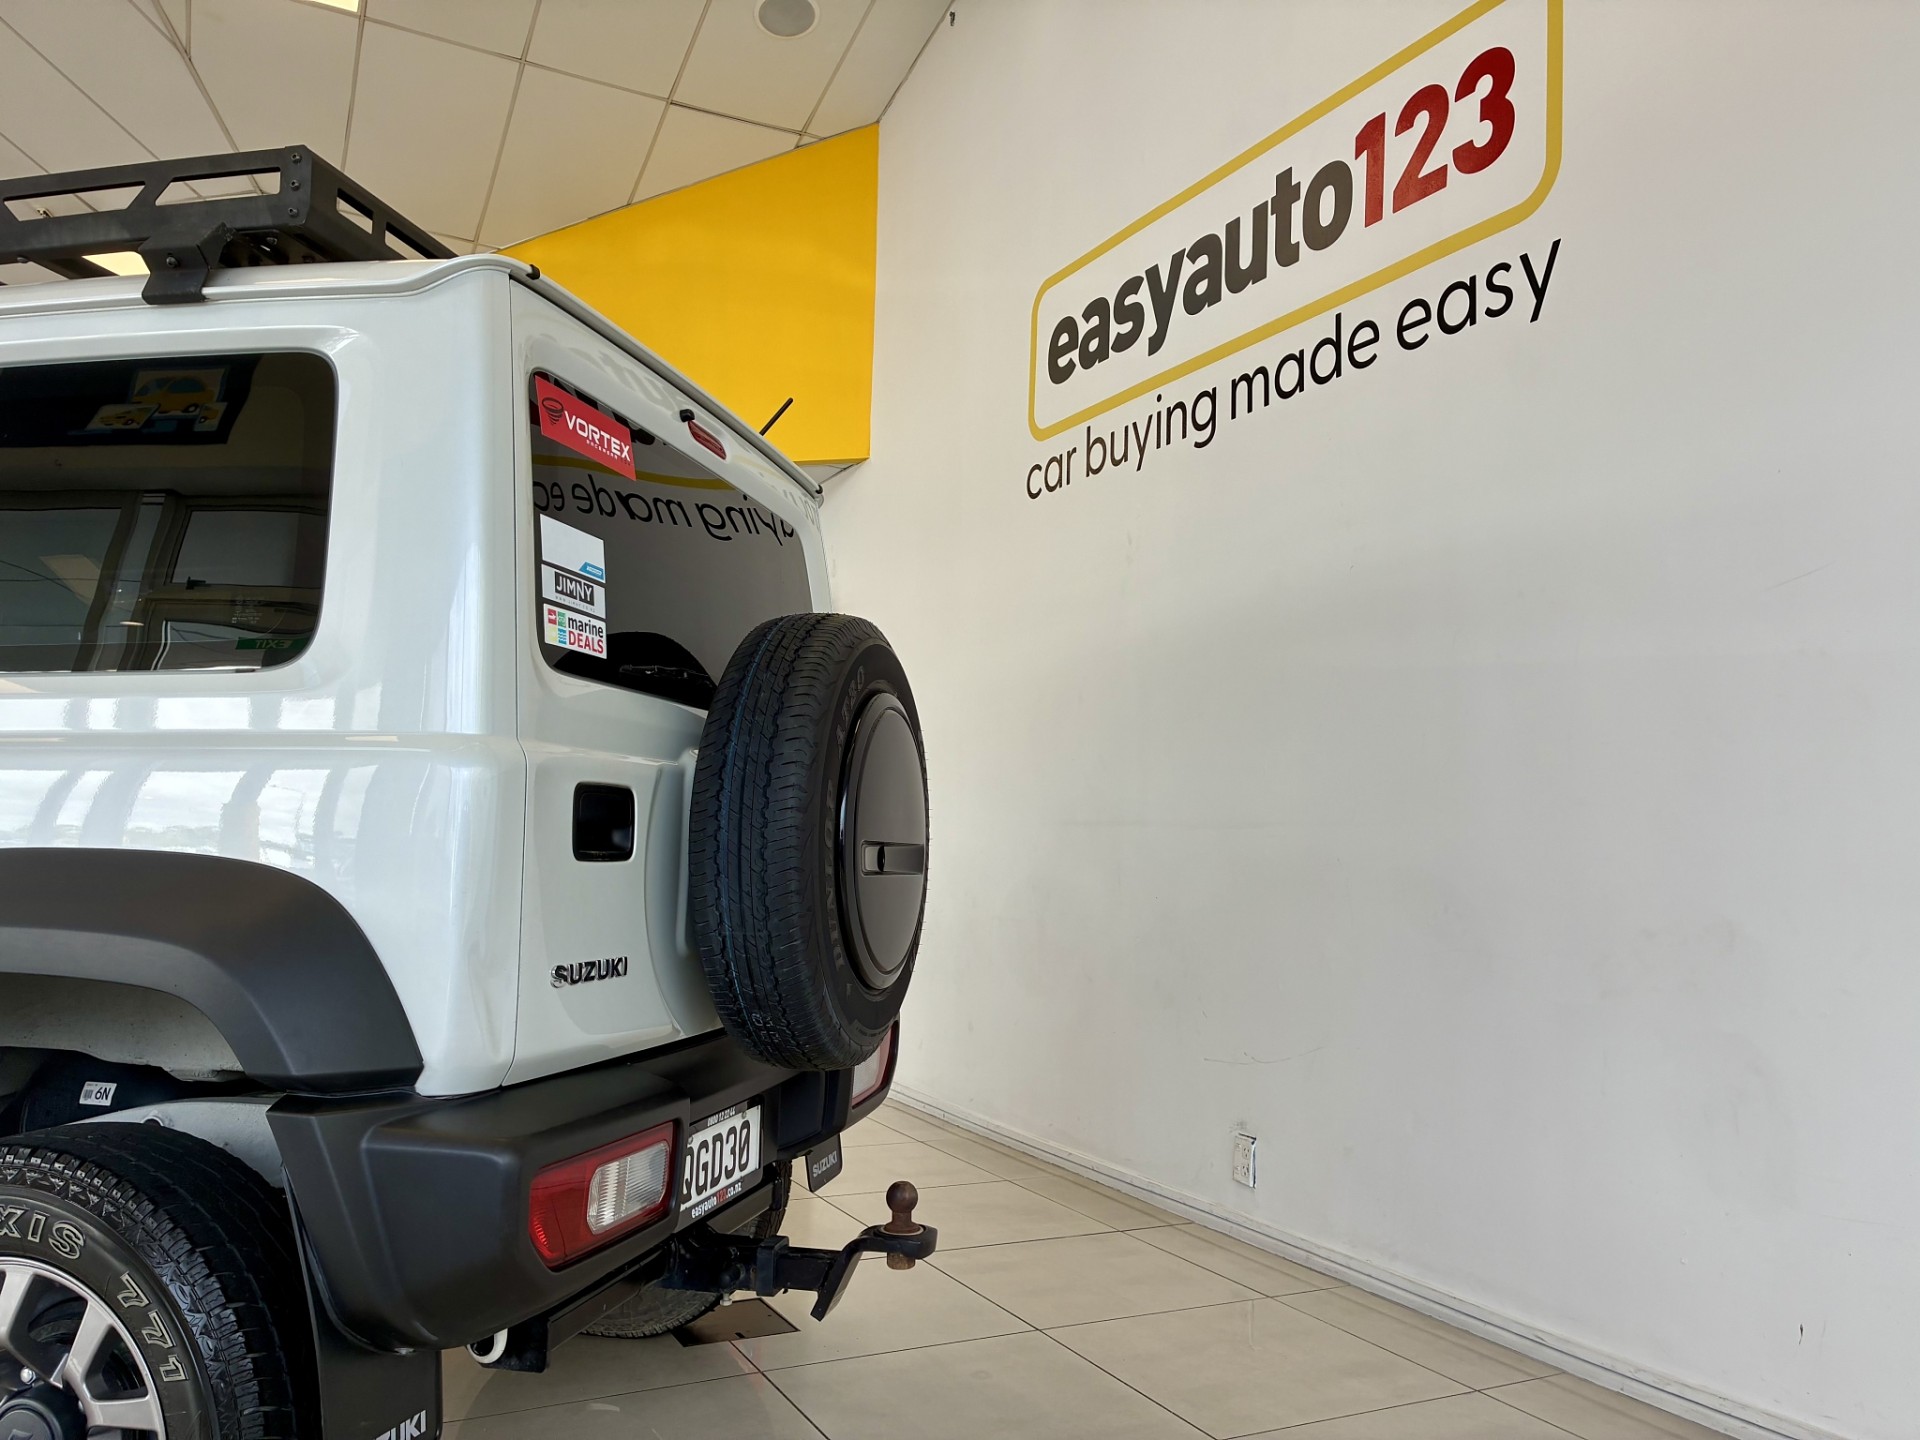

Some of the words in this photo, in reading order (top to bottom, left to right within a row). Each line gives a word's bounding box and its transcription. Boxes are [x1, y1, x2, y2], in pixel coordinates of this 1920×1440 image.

[1047, 46, 1516, 385] easyauto123
[1025, 445, 1077, 499] car
[1085, 386, 1218, 476] buying
[1230, 312, 1381, 421] made
[1396, 238, 1562, 351] easy
[564, 410, 631, 462] VORTEX
[556, 576, 593, 602] JIMNY
[567, 616, 604, 639] marine
[567, 630, 604, 655] DEALS
[550, 956, 628, 989] SUZUKI
[94, 1087, 112, 1101] 6N
[812, 1150, 838, 1178] SUZUKI
[116, 1269, 188, 1383] 771
